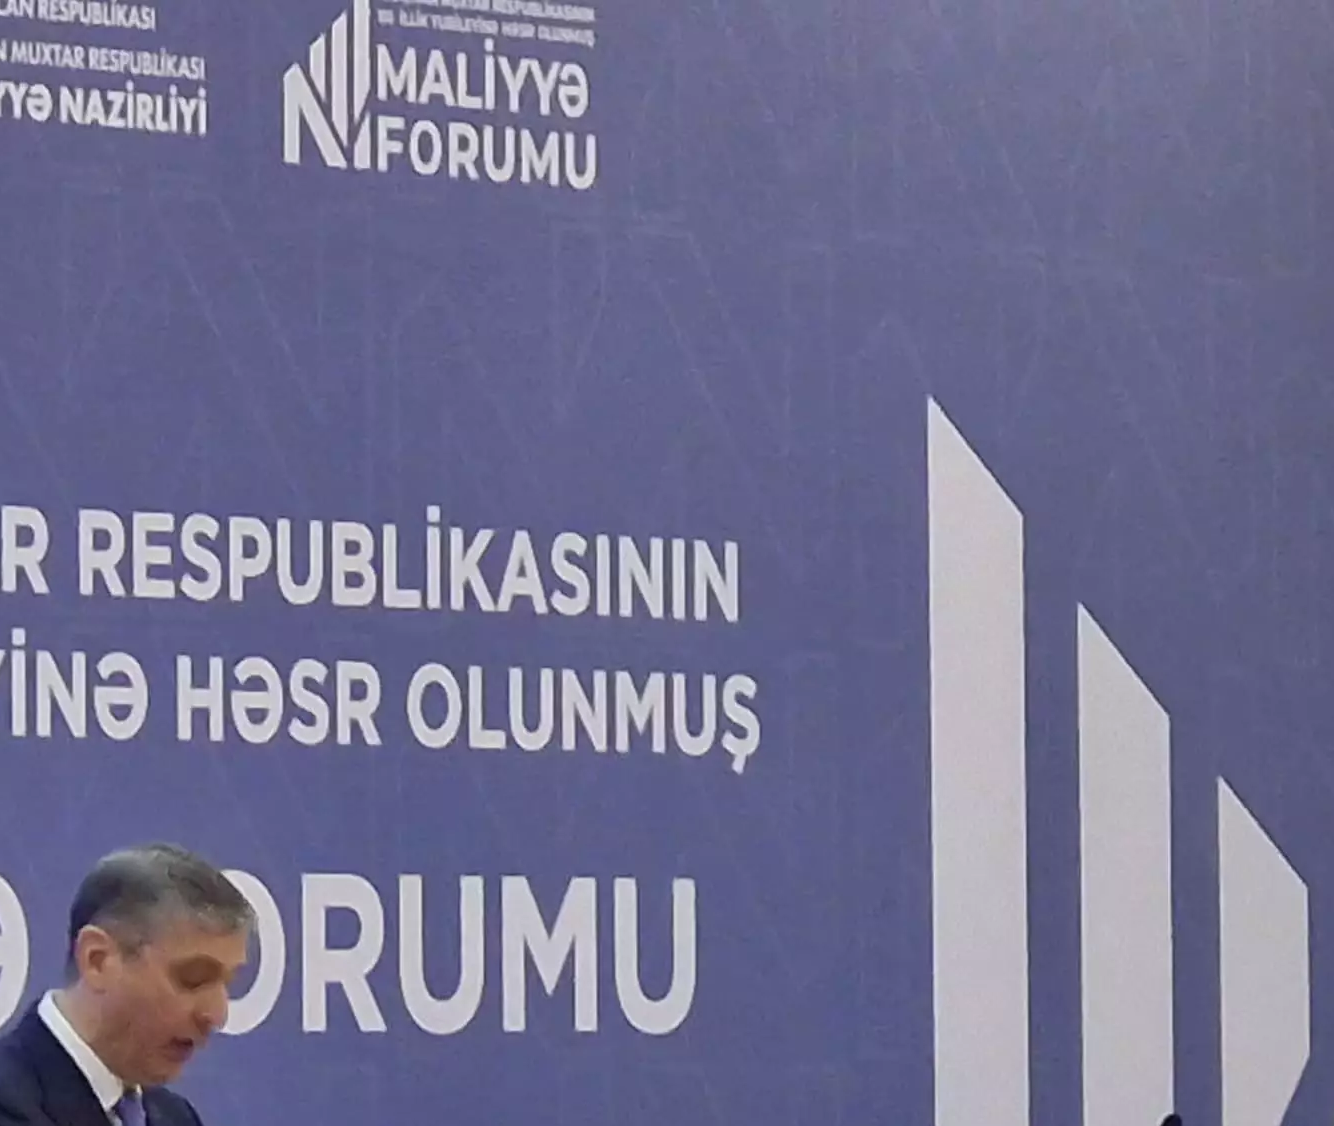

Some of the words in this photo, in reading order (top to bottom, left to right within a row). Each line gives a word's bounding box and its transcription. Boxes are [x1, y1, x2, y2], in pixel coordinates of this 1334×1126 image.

[11, 40, 85, 68] MUXTAR
[88, 47, 206, 80] RESPUBLİKASI
[375, 37, 589, 118] MALİYYƏ
[59, 79, 207, 136] NAZİRLİYİ
[376, 114, 597, 190] FORUMU
[78, 505, 739, 623] RESPUBLİKASININ
[177, 655, 382, 746] HƏSR
[406, 662, 761, 774] OLUNMUŞ
[219, 869, 697, 1036] RUMU
